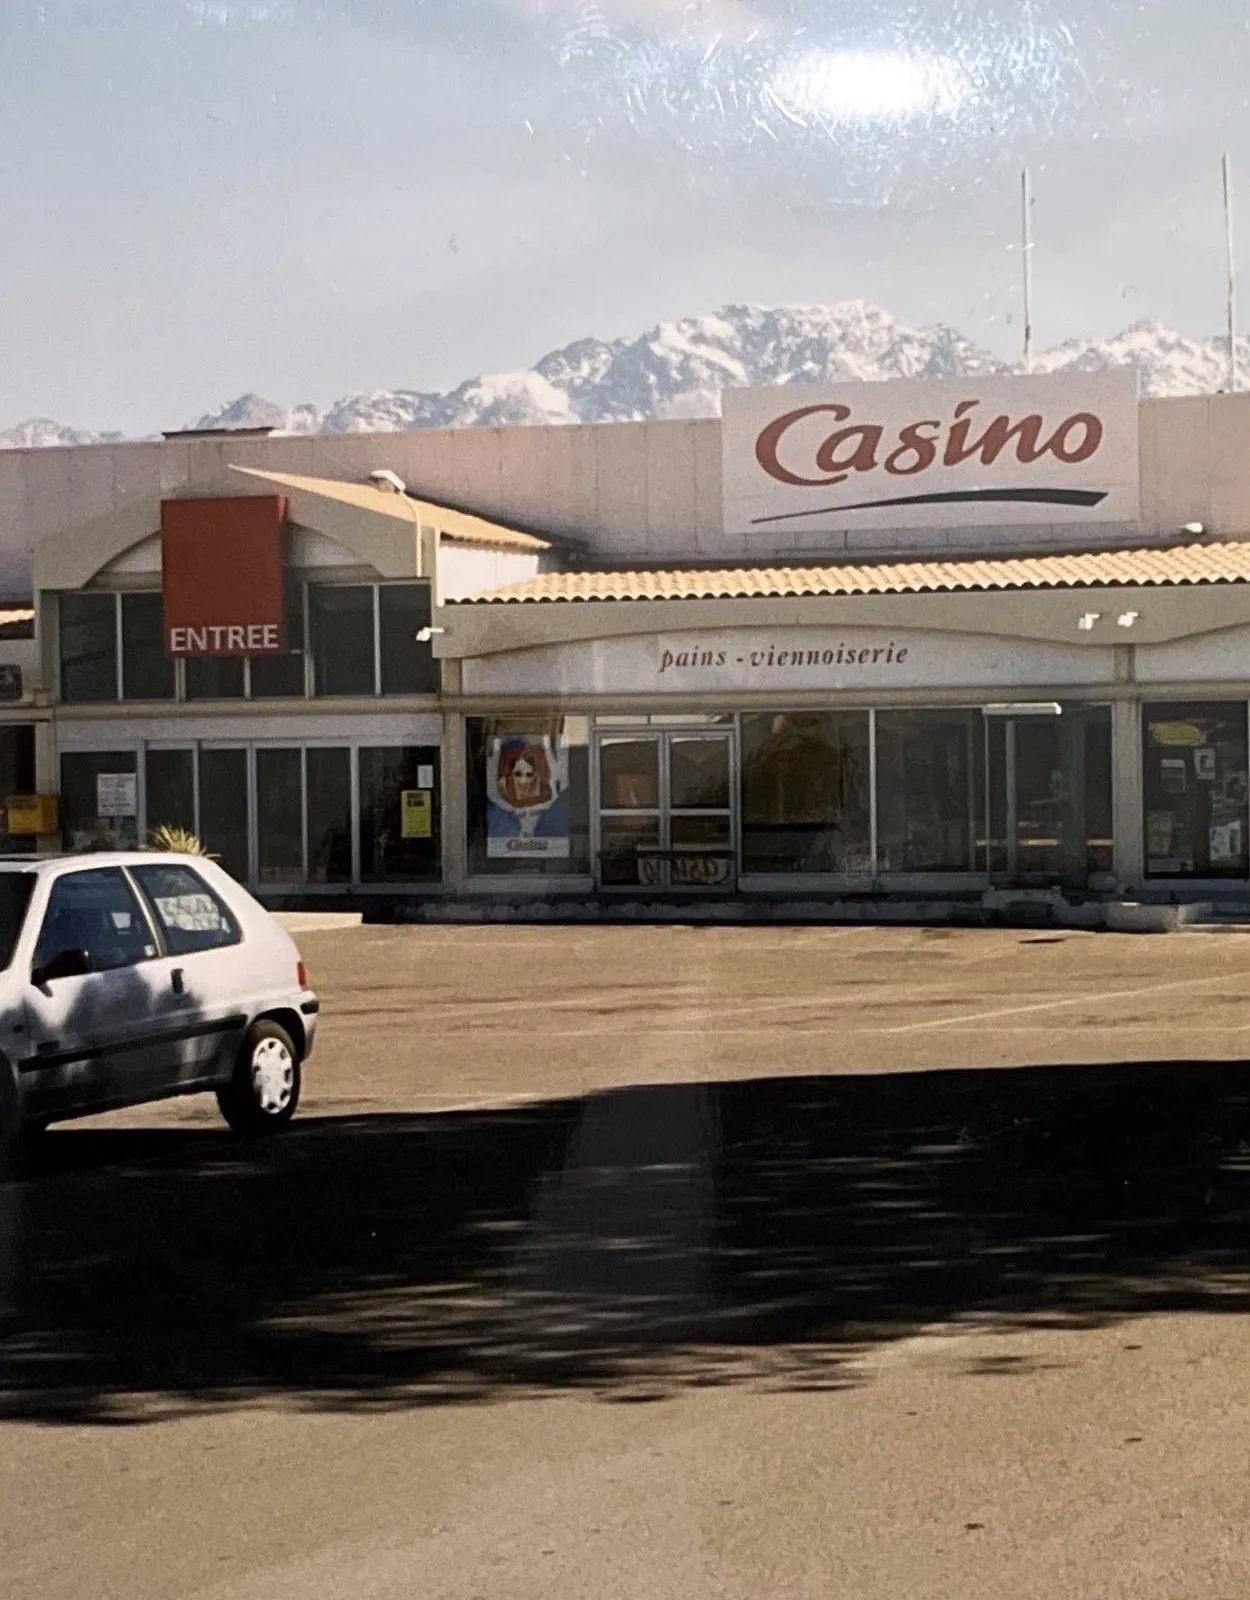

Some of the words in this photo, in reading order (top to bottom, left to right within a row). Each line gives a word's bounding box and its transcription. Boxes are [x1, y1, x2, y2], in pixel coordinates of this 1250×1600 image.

[754, 400, 1104, 487] Casino
[170, 624, 280, 652] ENTREE
[657, 645, 727, 673] pains
[750, 641, 909, 667] viennoiserie
